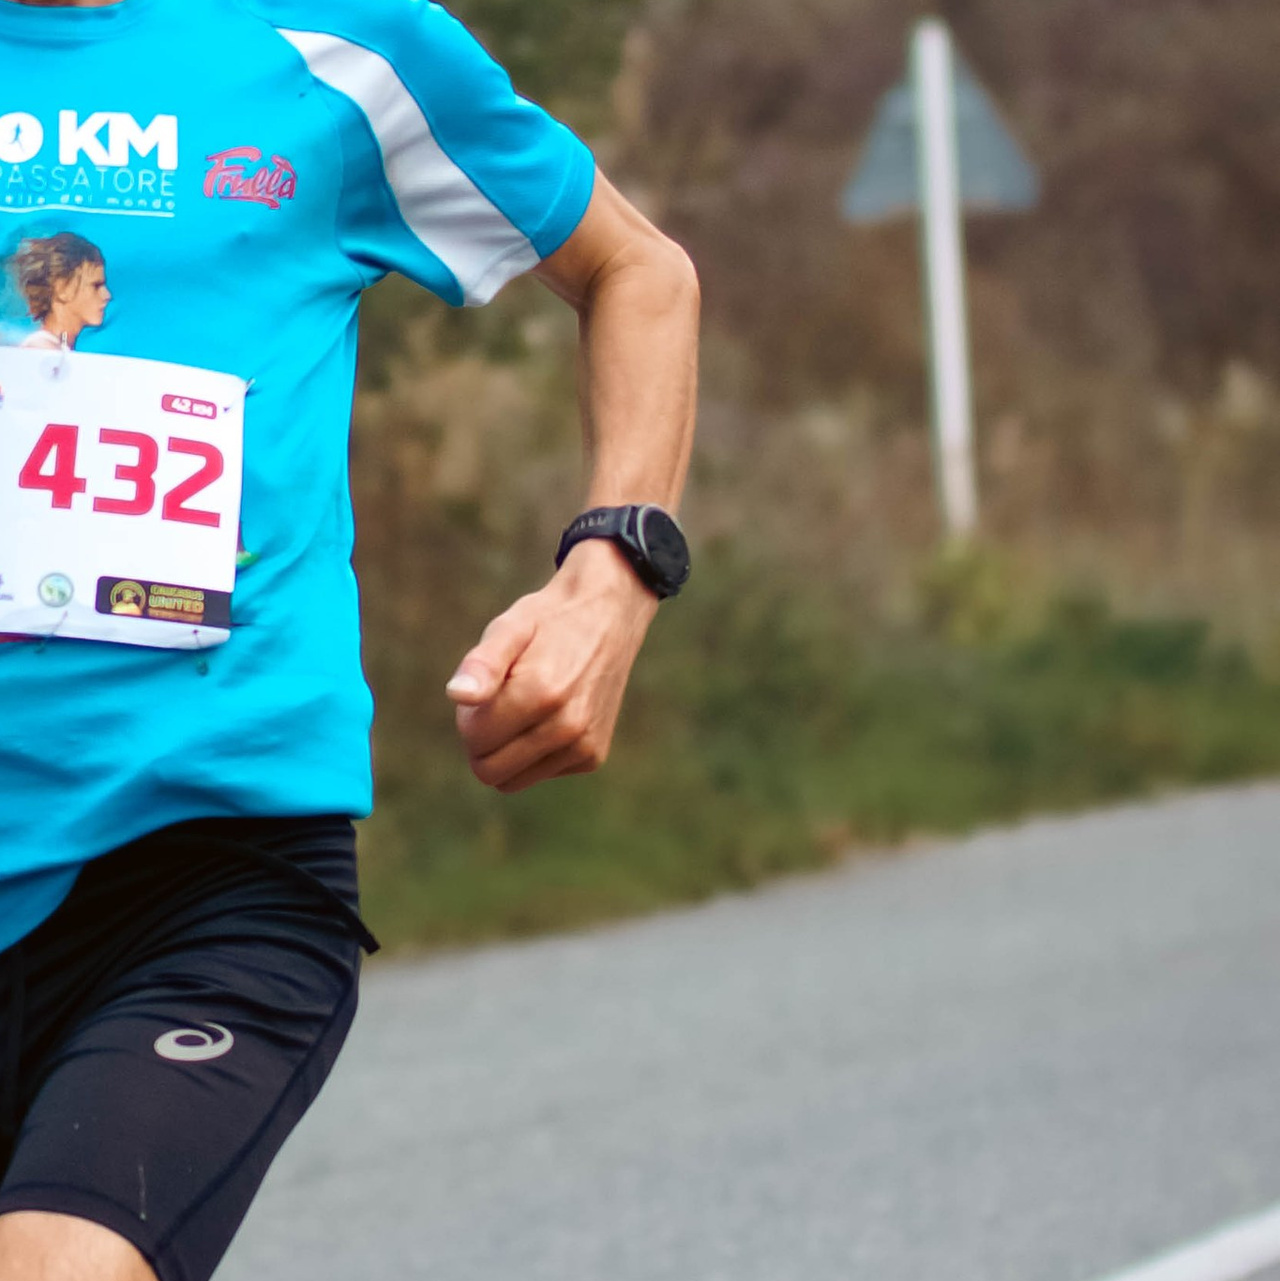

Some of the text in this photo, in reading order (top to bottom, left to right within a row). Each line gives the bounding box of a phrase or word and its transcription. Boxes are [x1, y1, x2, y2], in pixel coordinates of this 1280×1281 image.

[58, 109, 179, 170] KM
[59, 193, 93, 206] del
[106, 197, 175, 210] mondo
[18, 422, 225, 528] 432
[149, 595, 205, 614] UNITED
